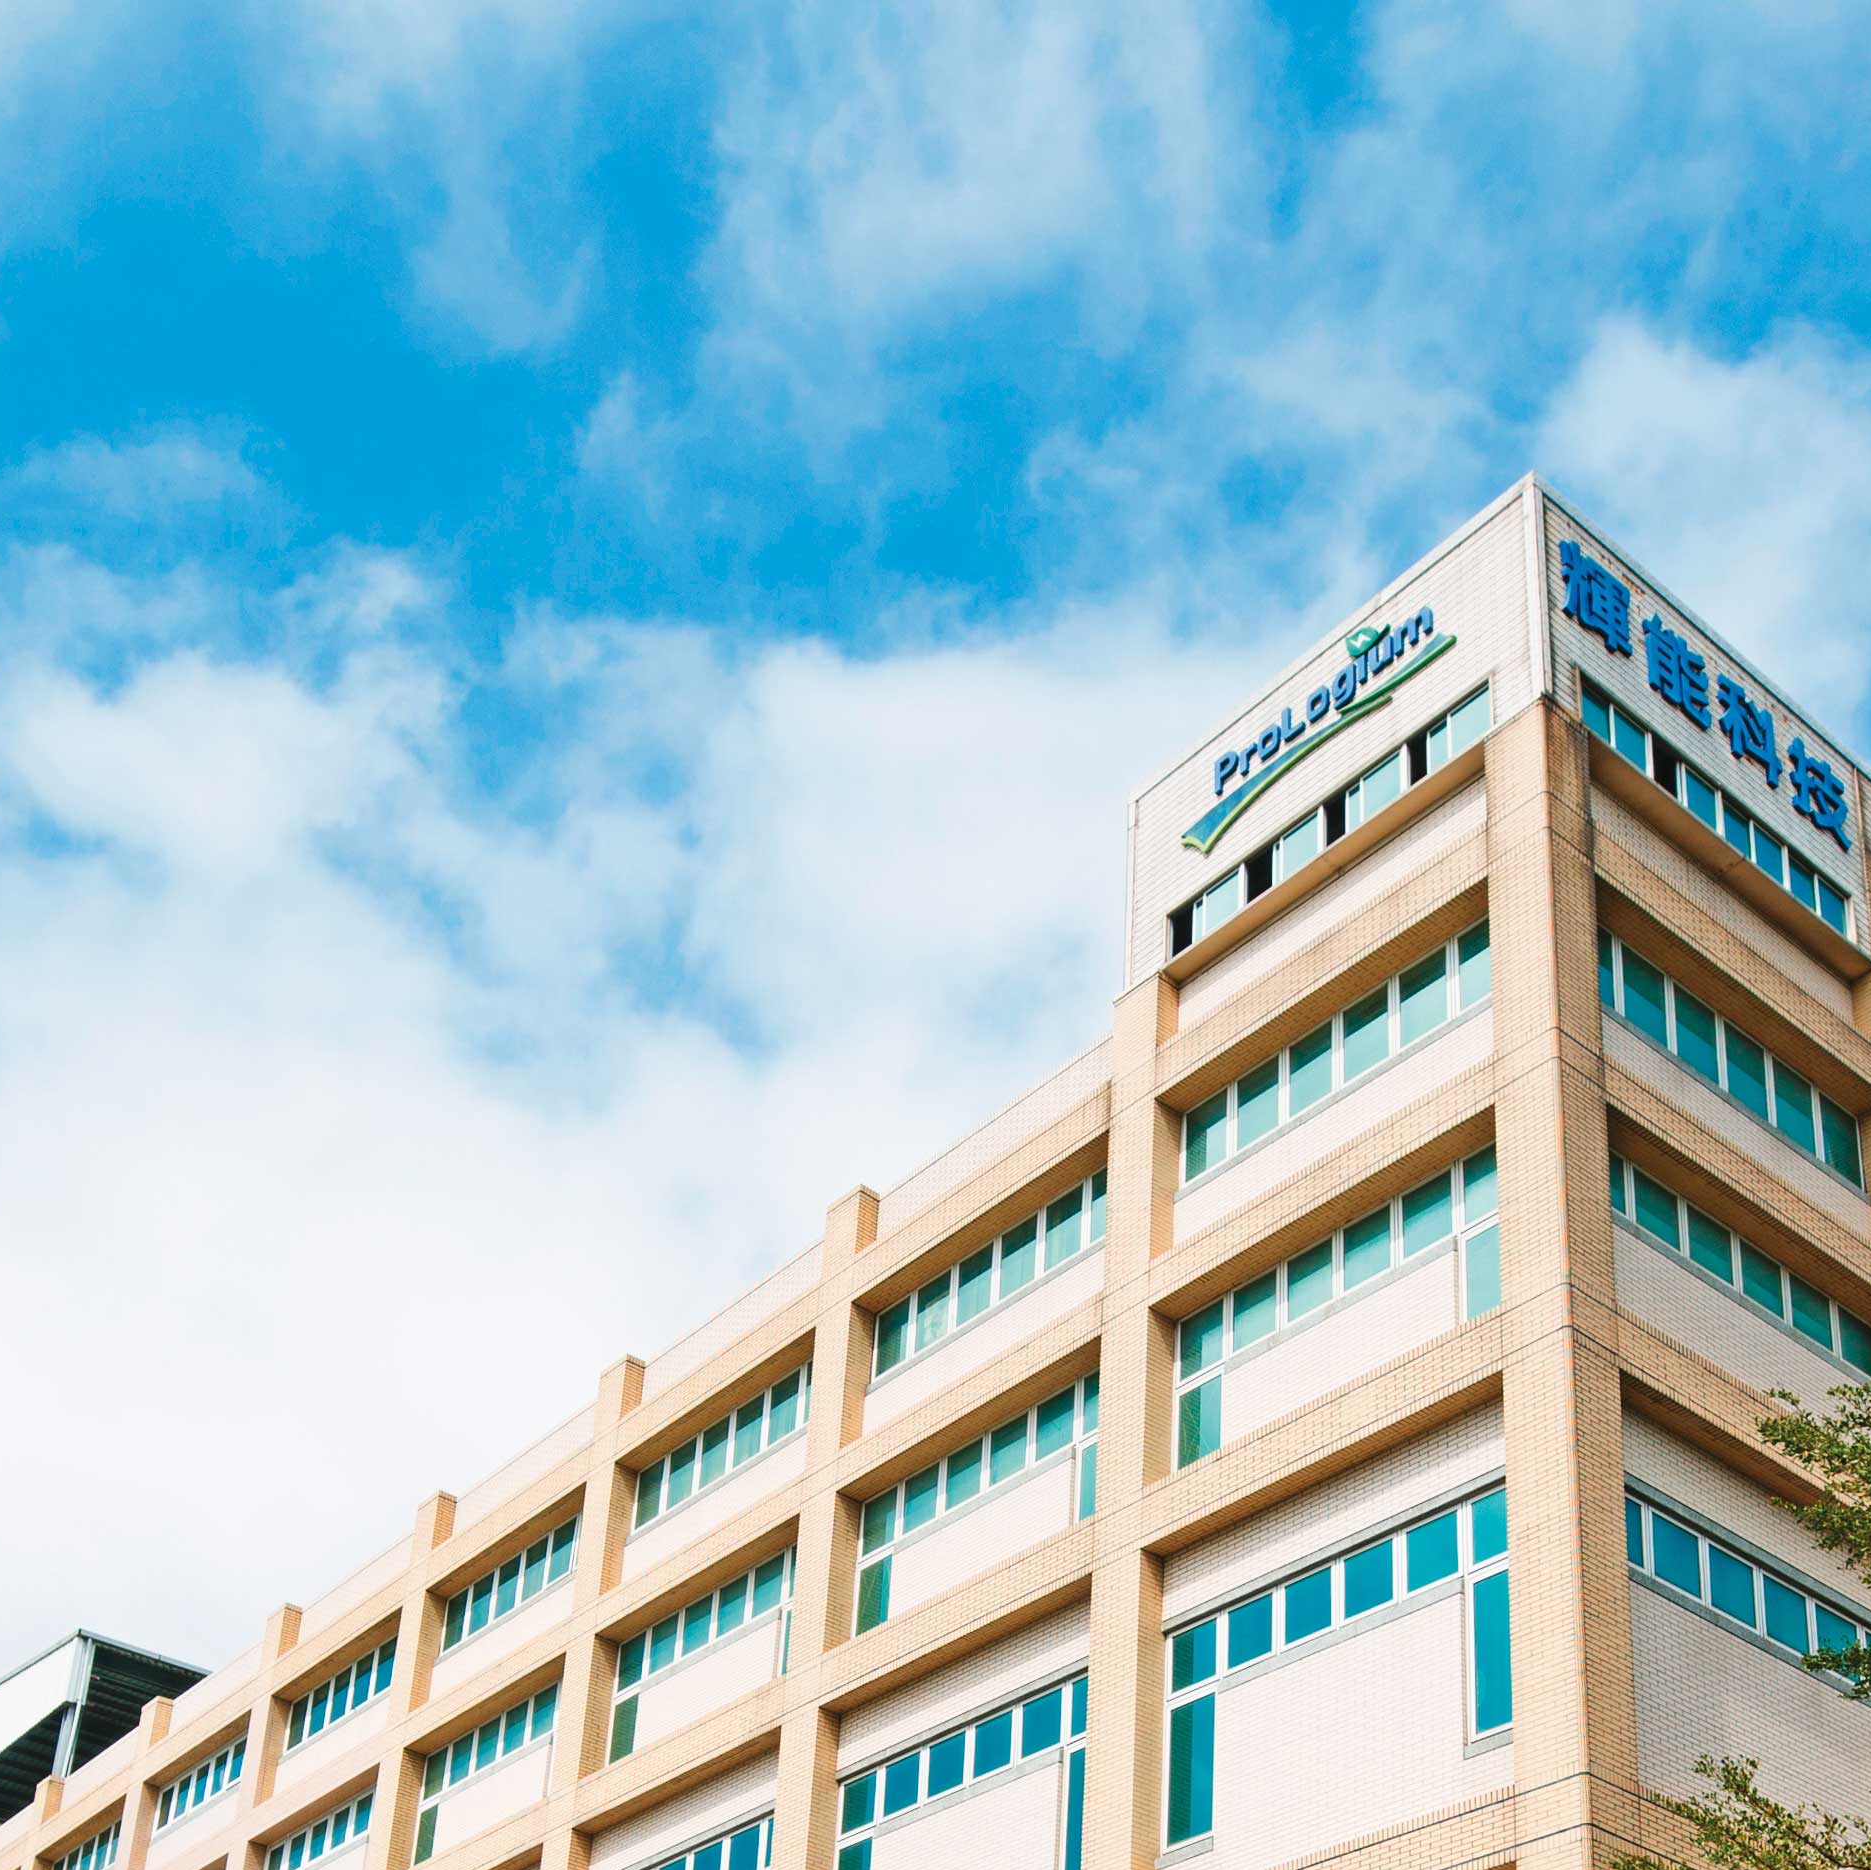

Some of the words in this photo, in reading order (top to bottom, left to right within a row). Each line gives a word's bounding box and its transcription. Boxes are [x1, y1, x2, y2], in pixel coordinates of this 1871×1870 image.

[1213, 605, 1434, 796] ProLogium
[1558, 539, 1853, 852] 輝能科技
